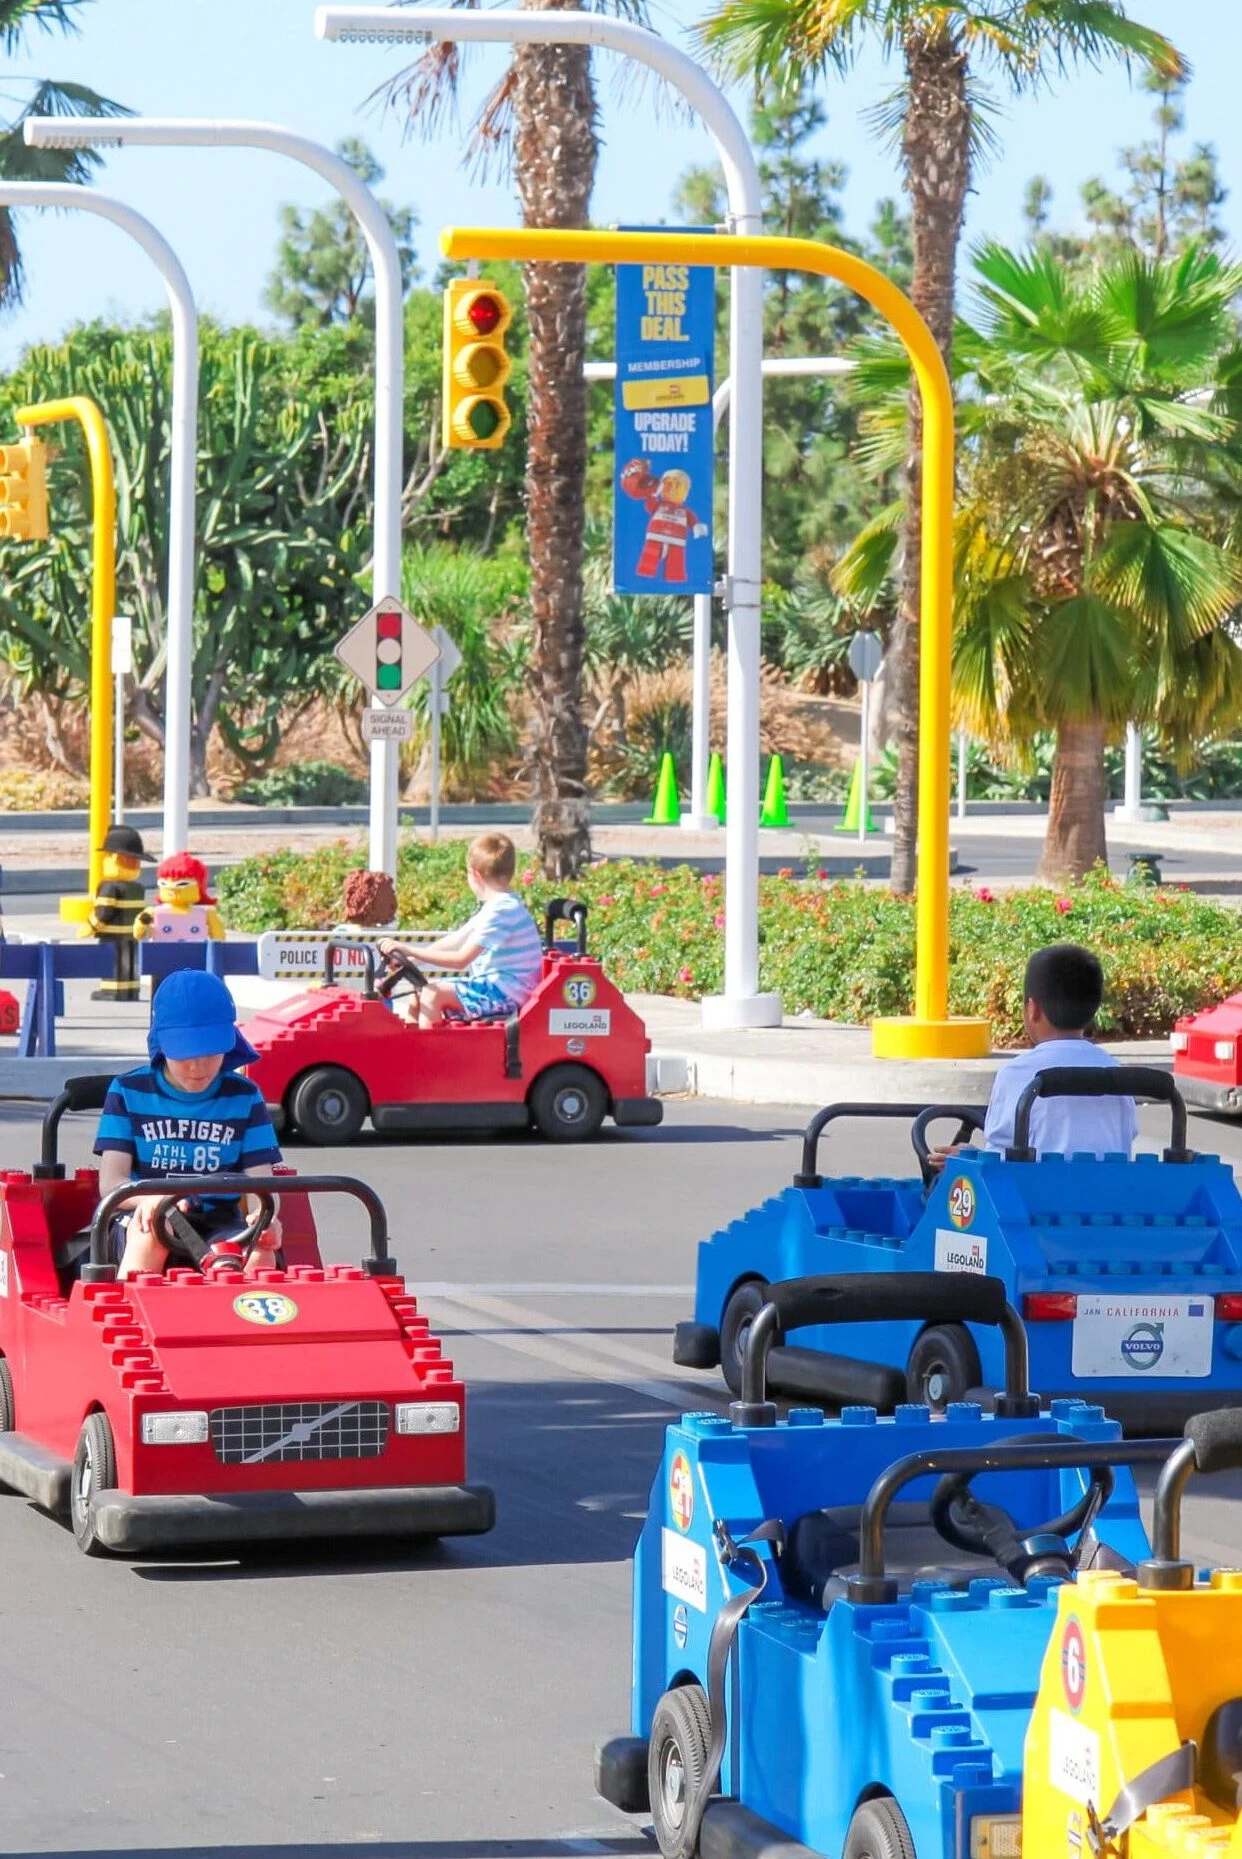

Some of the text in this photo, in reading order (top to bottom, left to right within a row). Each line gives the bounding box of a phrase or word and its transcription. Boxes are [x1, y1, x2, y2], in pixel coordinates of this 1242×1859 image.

[643, 266, 689, 290] PASS
[645, 291, 686, 316] THIS
[628, 357, 701, 373] MEMBERSHIP
[634, 412, 697, 432] UPGRADE
[640, 433, 689, 453] TODAY!
[370, 714, 407, 725] SIGNAL
[371, 726, 406, 736] AHEAD
[280, 950, 318, 965] POLICE
[568, 982, 590, 1001] 36
[564, 1021, 608, 1030] LEGOLAND
[141, 1119, 235, 1146] HILFIGER
[154, 1144, 187, 1158] ATHL
[193, 1146, 221, 1172] 85
[151, 1157, 188, 1171] DEPT
[953, 1187, 972, 1218] 29
[947, 1252, 985, 1269] LEGOLAND
[241, 1298, 289, 1318] 38
[1084, 1307, 1180, 1317] JAN CALIFORNIA
[1123, 1342, 1161, 1351] VOLVO
[672, 1564, 705, 1595] LEGOLAND
[1067, 1636, 1080, 1694] 6
